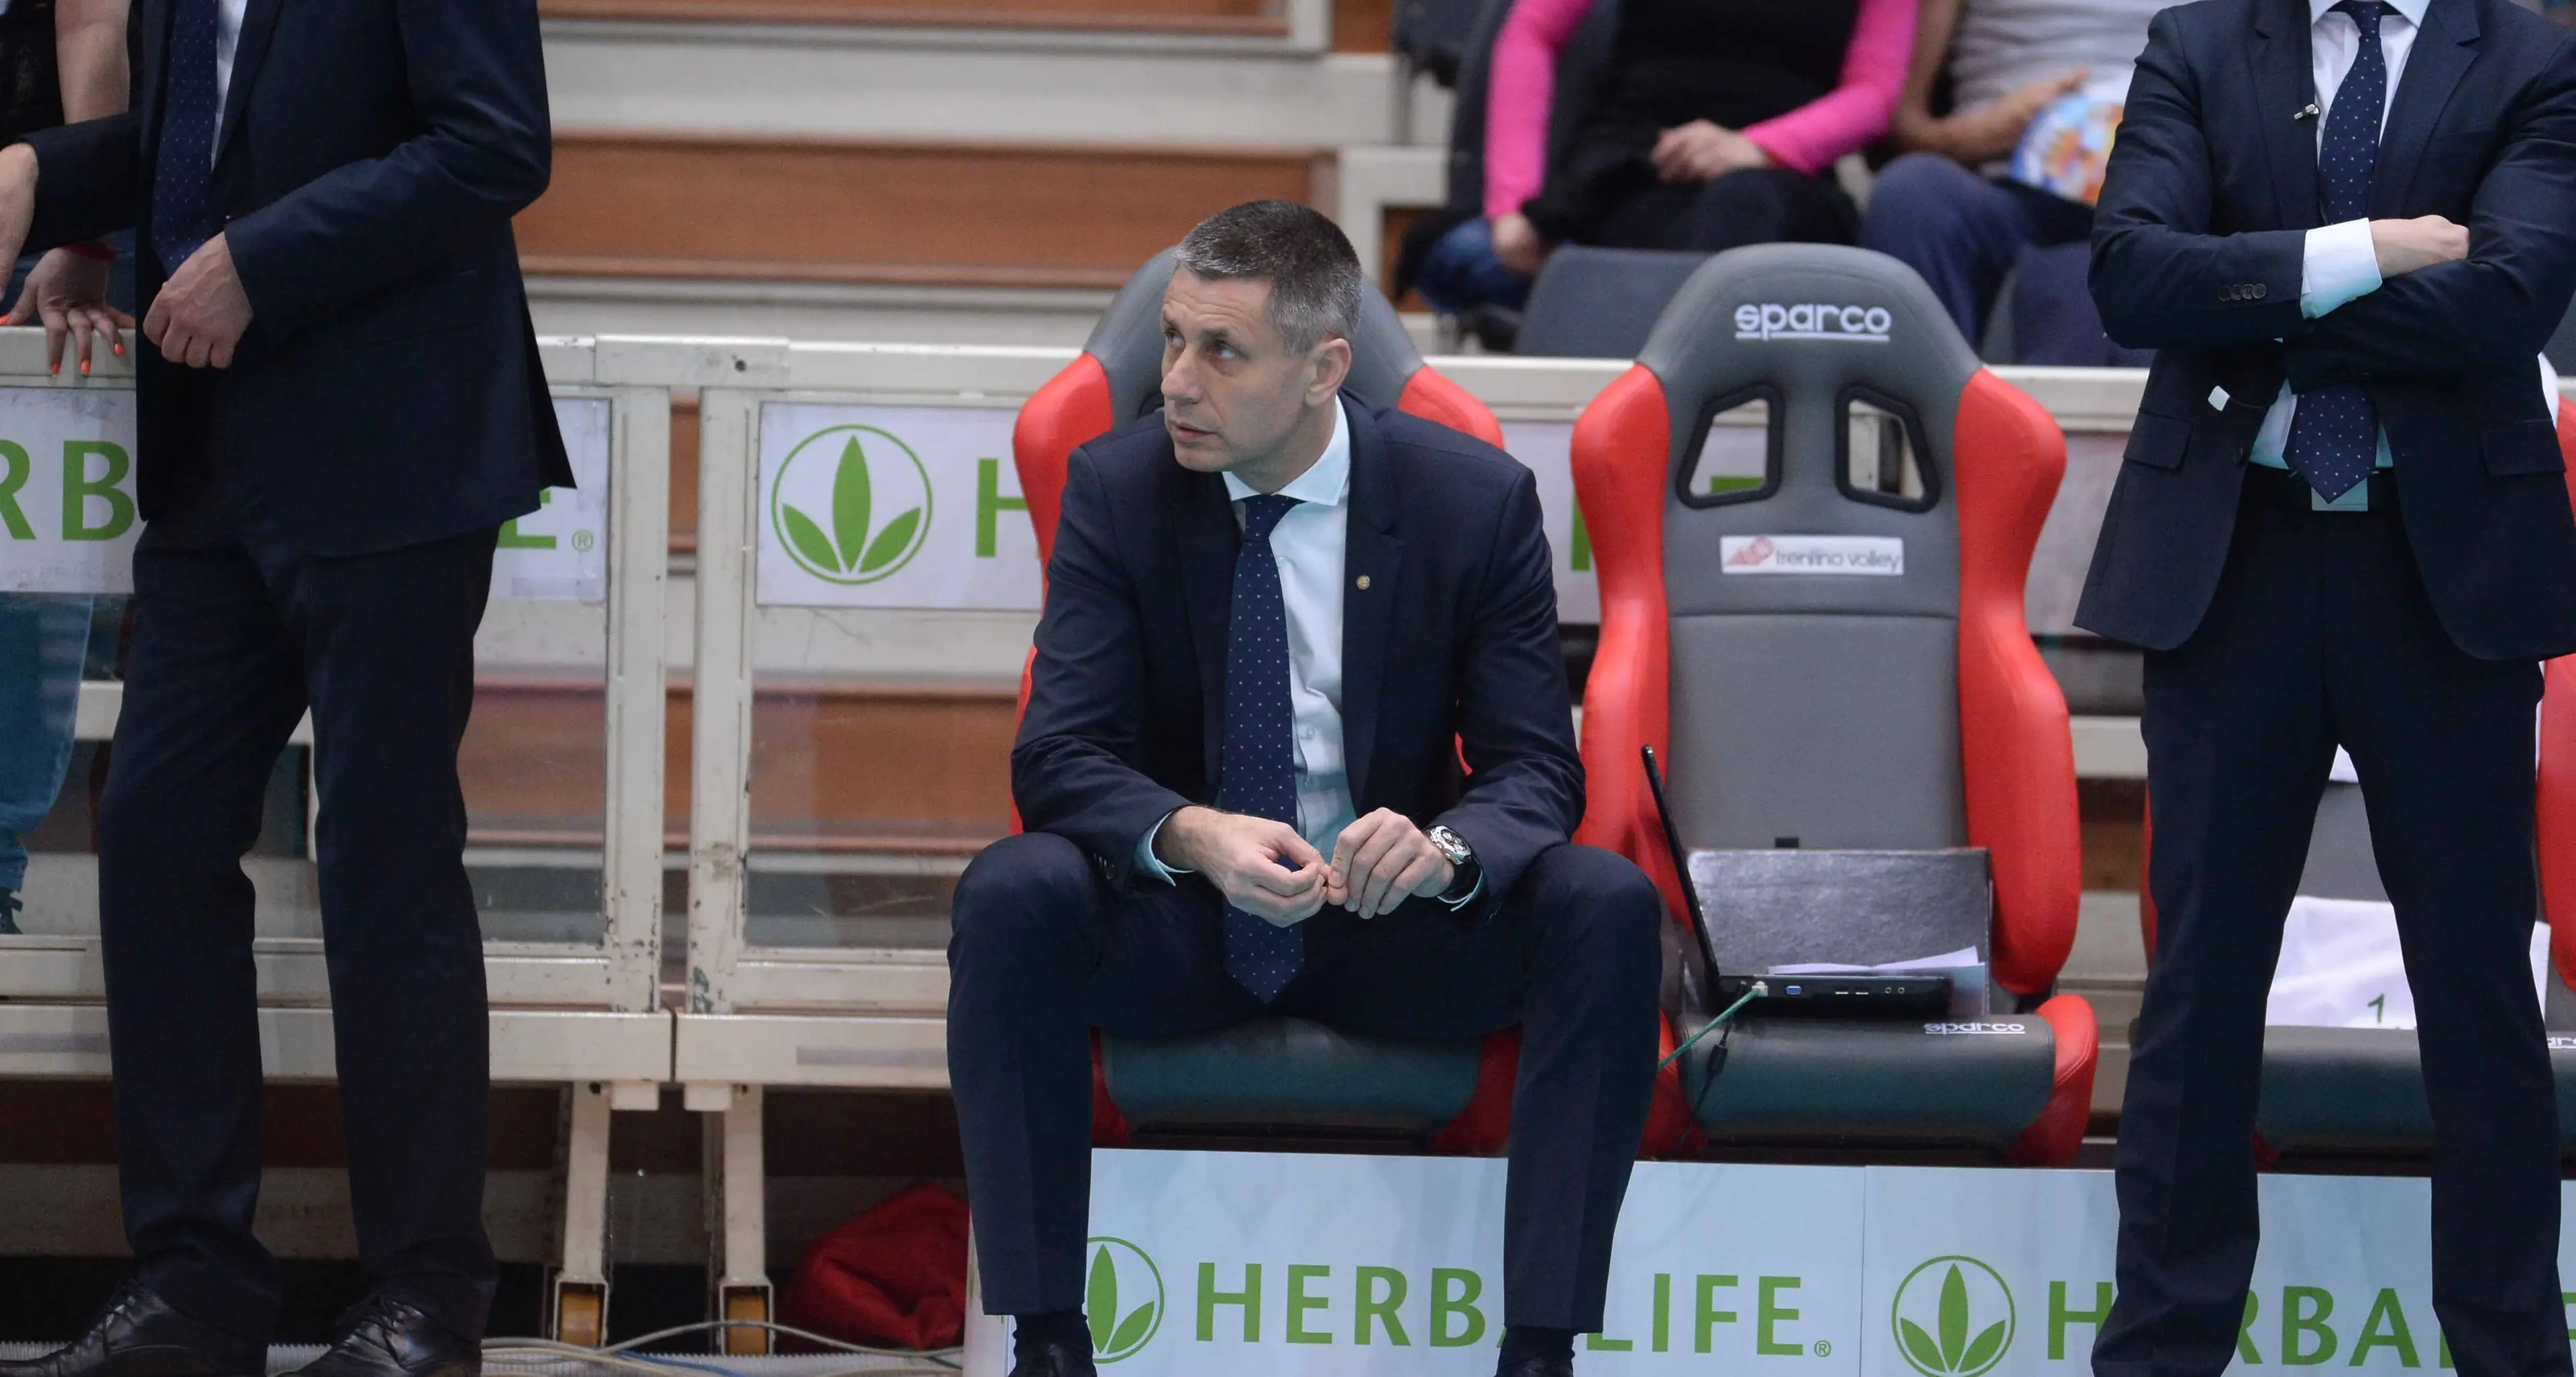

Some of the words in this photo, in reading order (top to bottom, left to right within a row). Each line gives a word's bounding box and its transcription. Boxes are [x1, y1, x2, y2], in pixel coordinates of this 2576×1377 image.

[1734, 304, 1891, 341] sparco
[1848, 549, 1901, 572] volley
[2367, 993, 2384, 1024] 1
[1924, 1022, 2025, 1035] sparco
